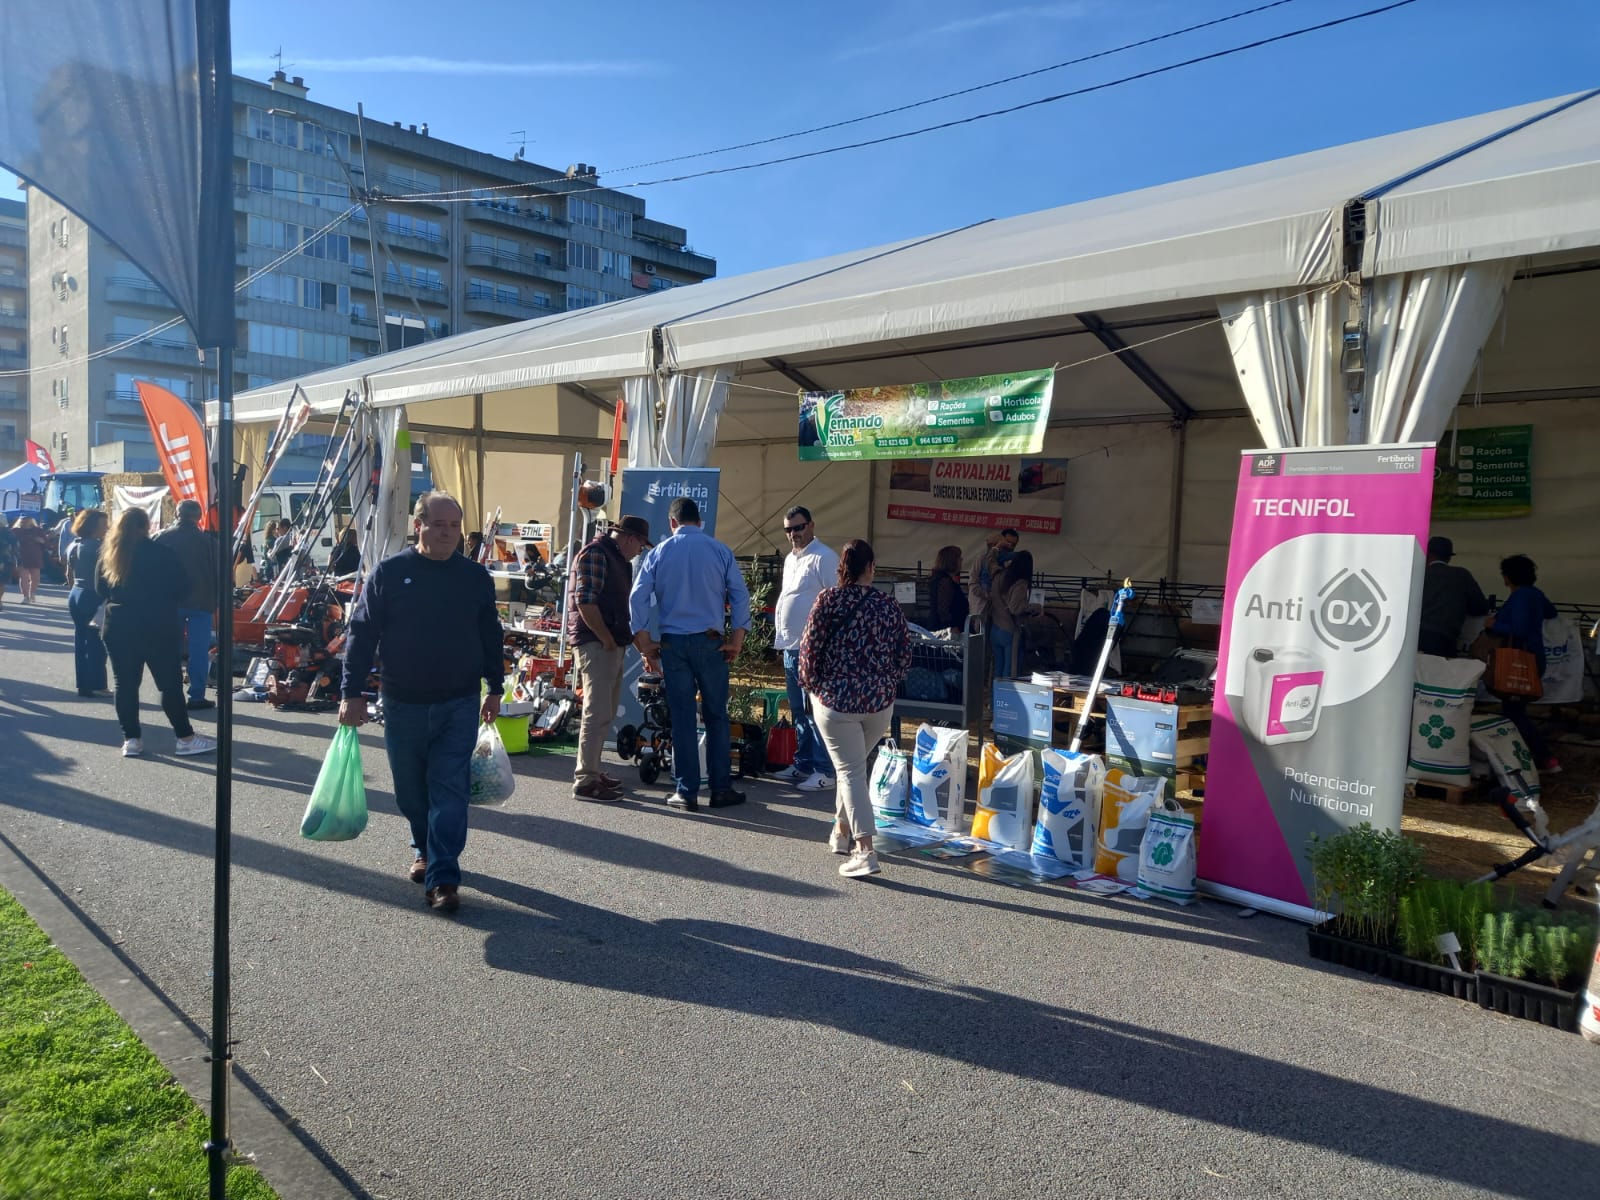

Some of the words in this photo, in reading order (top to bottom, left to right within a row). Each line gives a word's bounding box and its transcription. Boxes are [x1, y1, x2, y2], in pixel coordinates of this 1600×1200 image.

[940, 401, 966, 411] Rações
[938, 416, 975, 426] Sementes
[1005, 413, 1036, 422] Adubos
[829, 432, 855, 446] silva
[1475, 447, 1513, 457] Rações
[1258, 459, 1276, 467] ADP
[1377, 454, 1415, 463] Fertiberia
[1394, 462, 1415, 470] TECH
[1475, 461, 1526, 470] Sementes
[935, 461, 1011, 481] CARVALHAL
[647, 482, 709, 499] Fertiberia
[982, 487, 1013, 503] FORRAGENS
[1475, 489, 1514, 498] Adubos
[1253, 498, 1356, 518] TECNIFOL
[521, 526, 543, 537] STIHL
[1245, 594, 1304, 621] Anti
[1285, 767, 1377, 797] Potenciador
[1290, 788, 1374, 818] Nutricional
